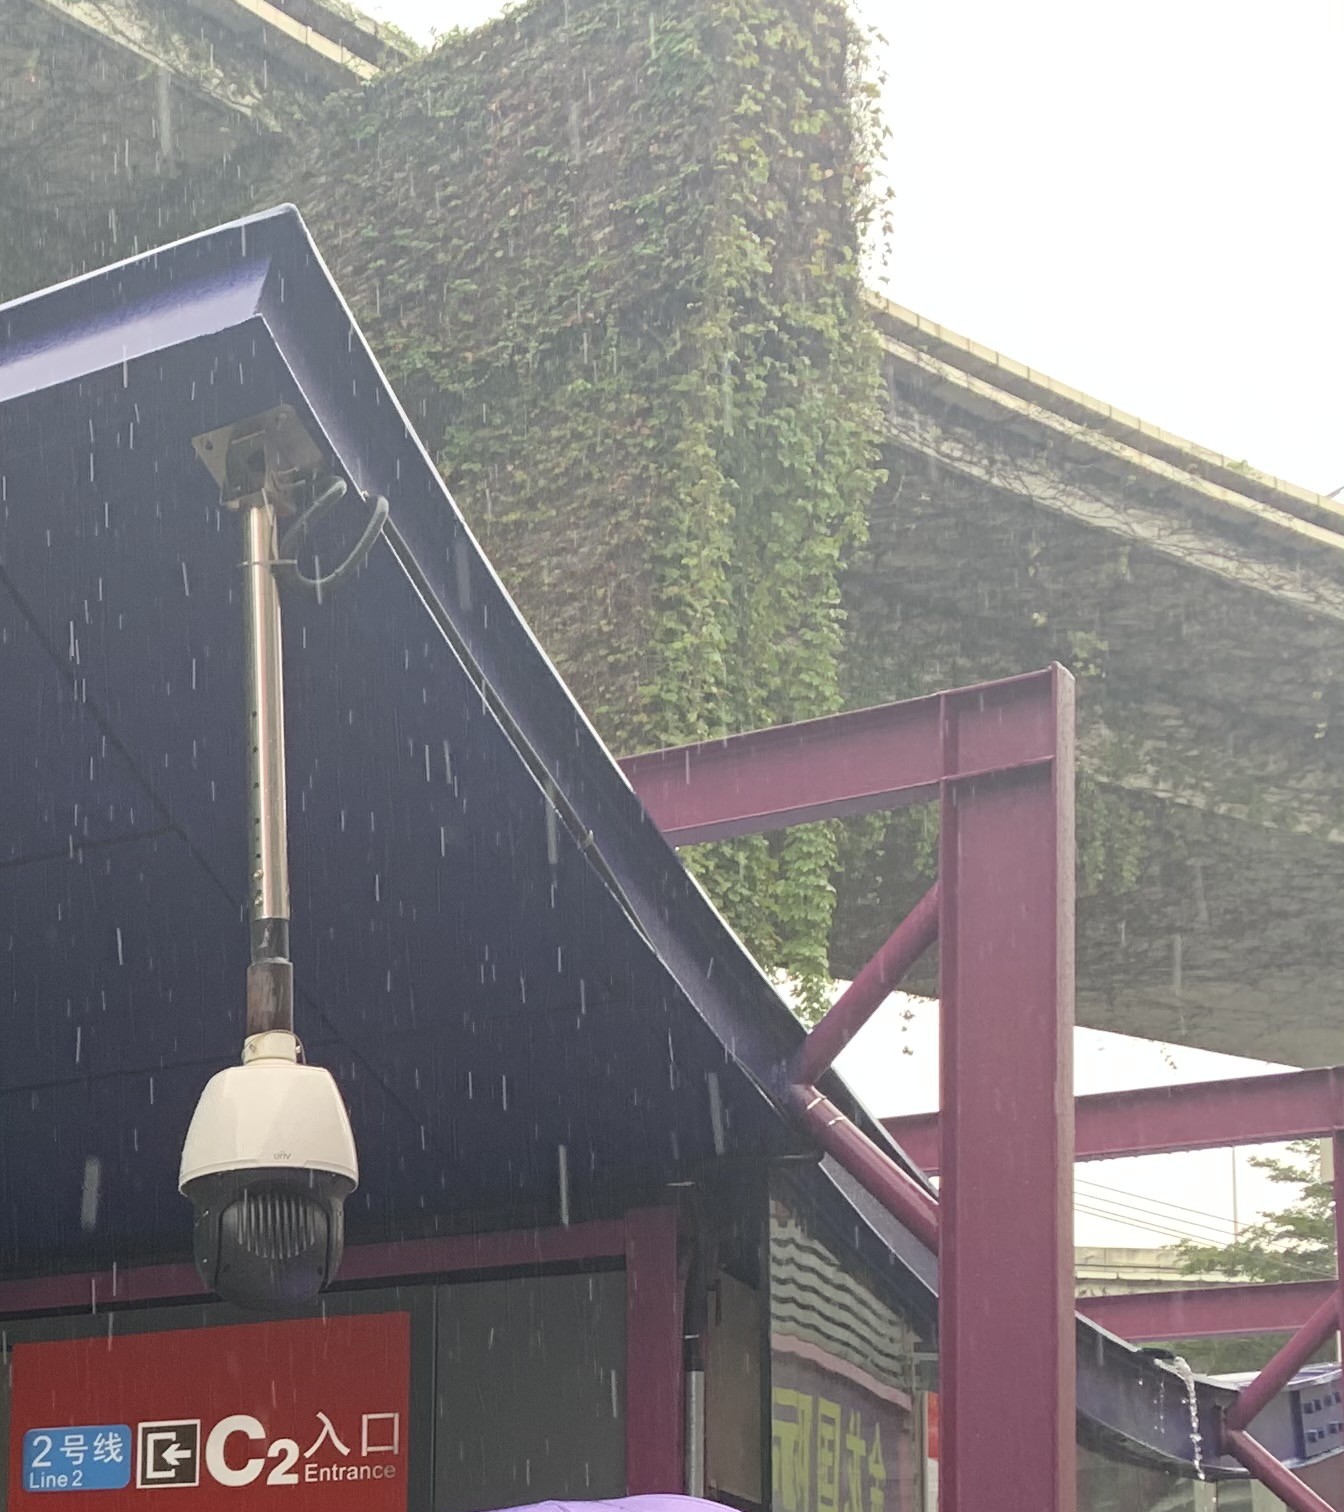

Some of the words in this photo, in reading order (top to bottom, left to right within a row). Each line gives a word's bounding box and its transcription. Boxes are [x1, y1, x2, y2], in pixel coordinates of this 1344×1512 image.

[32, 1432, 123, 1468] 2号线
[303, 1411, 400, 1457] 入口
[304, 1463, 396, 1483] Entrance
